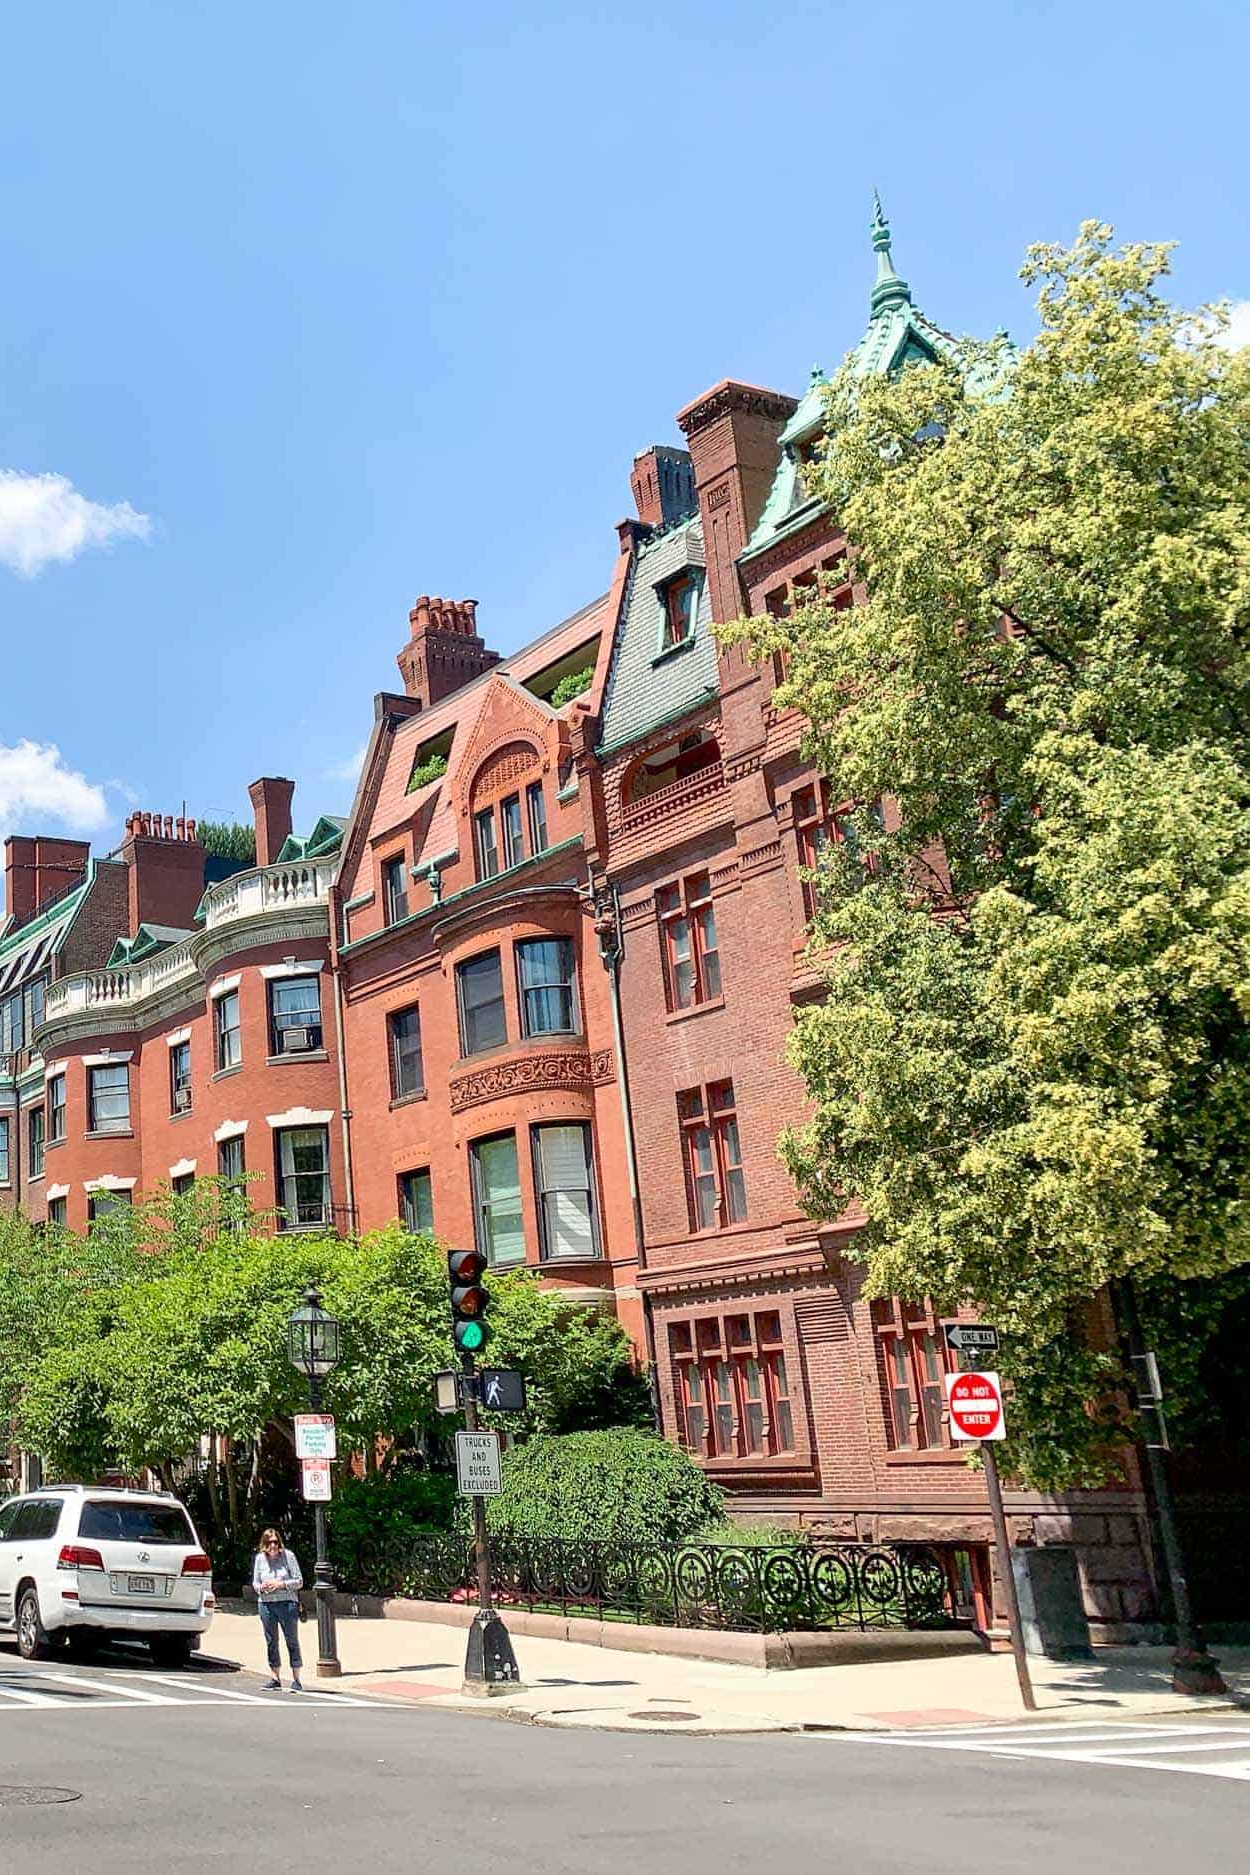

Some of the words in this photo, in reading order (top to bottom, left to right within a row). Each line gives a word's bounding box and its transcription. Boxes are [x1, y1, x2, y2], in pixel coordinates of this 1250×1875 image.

[961, 1331, 975, 1342] ONE
[978, 1331, 993, 1342] WAY
[955, 1386, 969, 1397] DO
[972, 1386, 991, 1397] NOT
[962, 1414, 991, 1425] ENTER
[465, 1437, 492, 1448] TRUCKS
[472, 1451, 487, 1461] AND
[469, 1465, 491, 1476] BUSES
[463, 1479, 498, 1490] EXCLUDED
